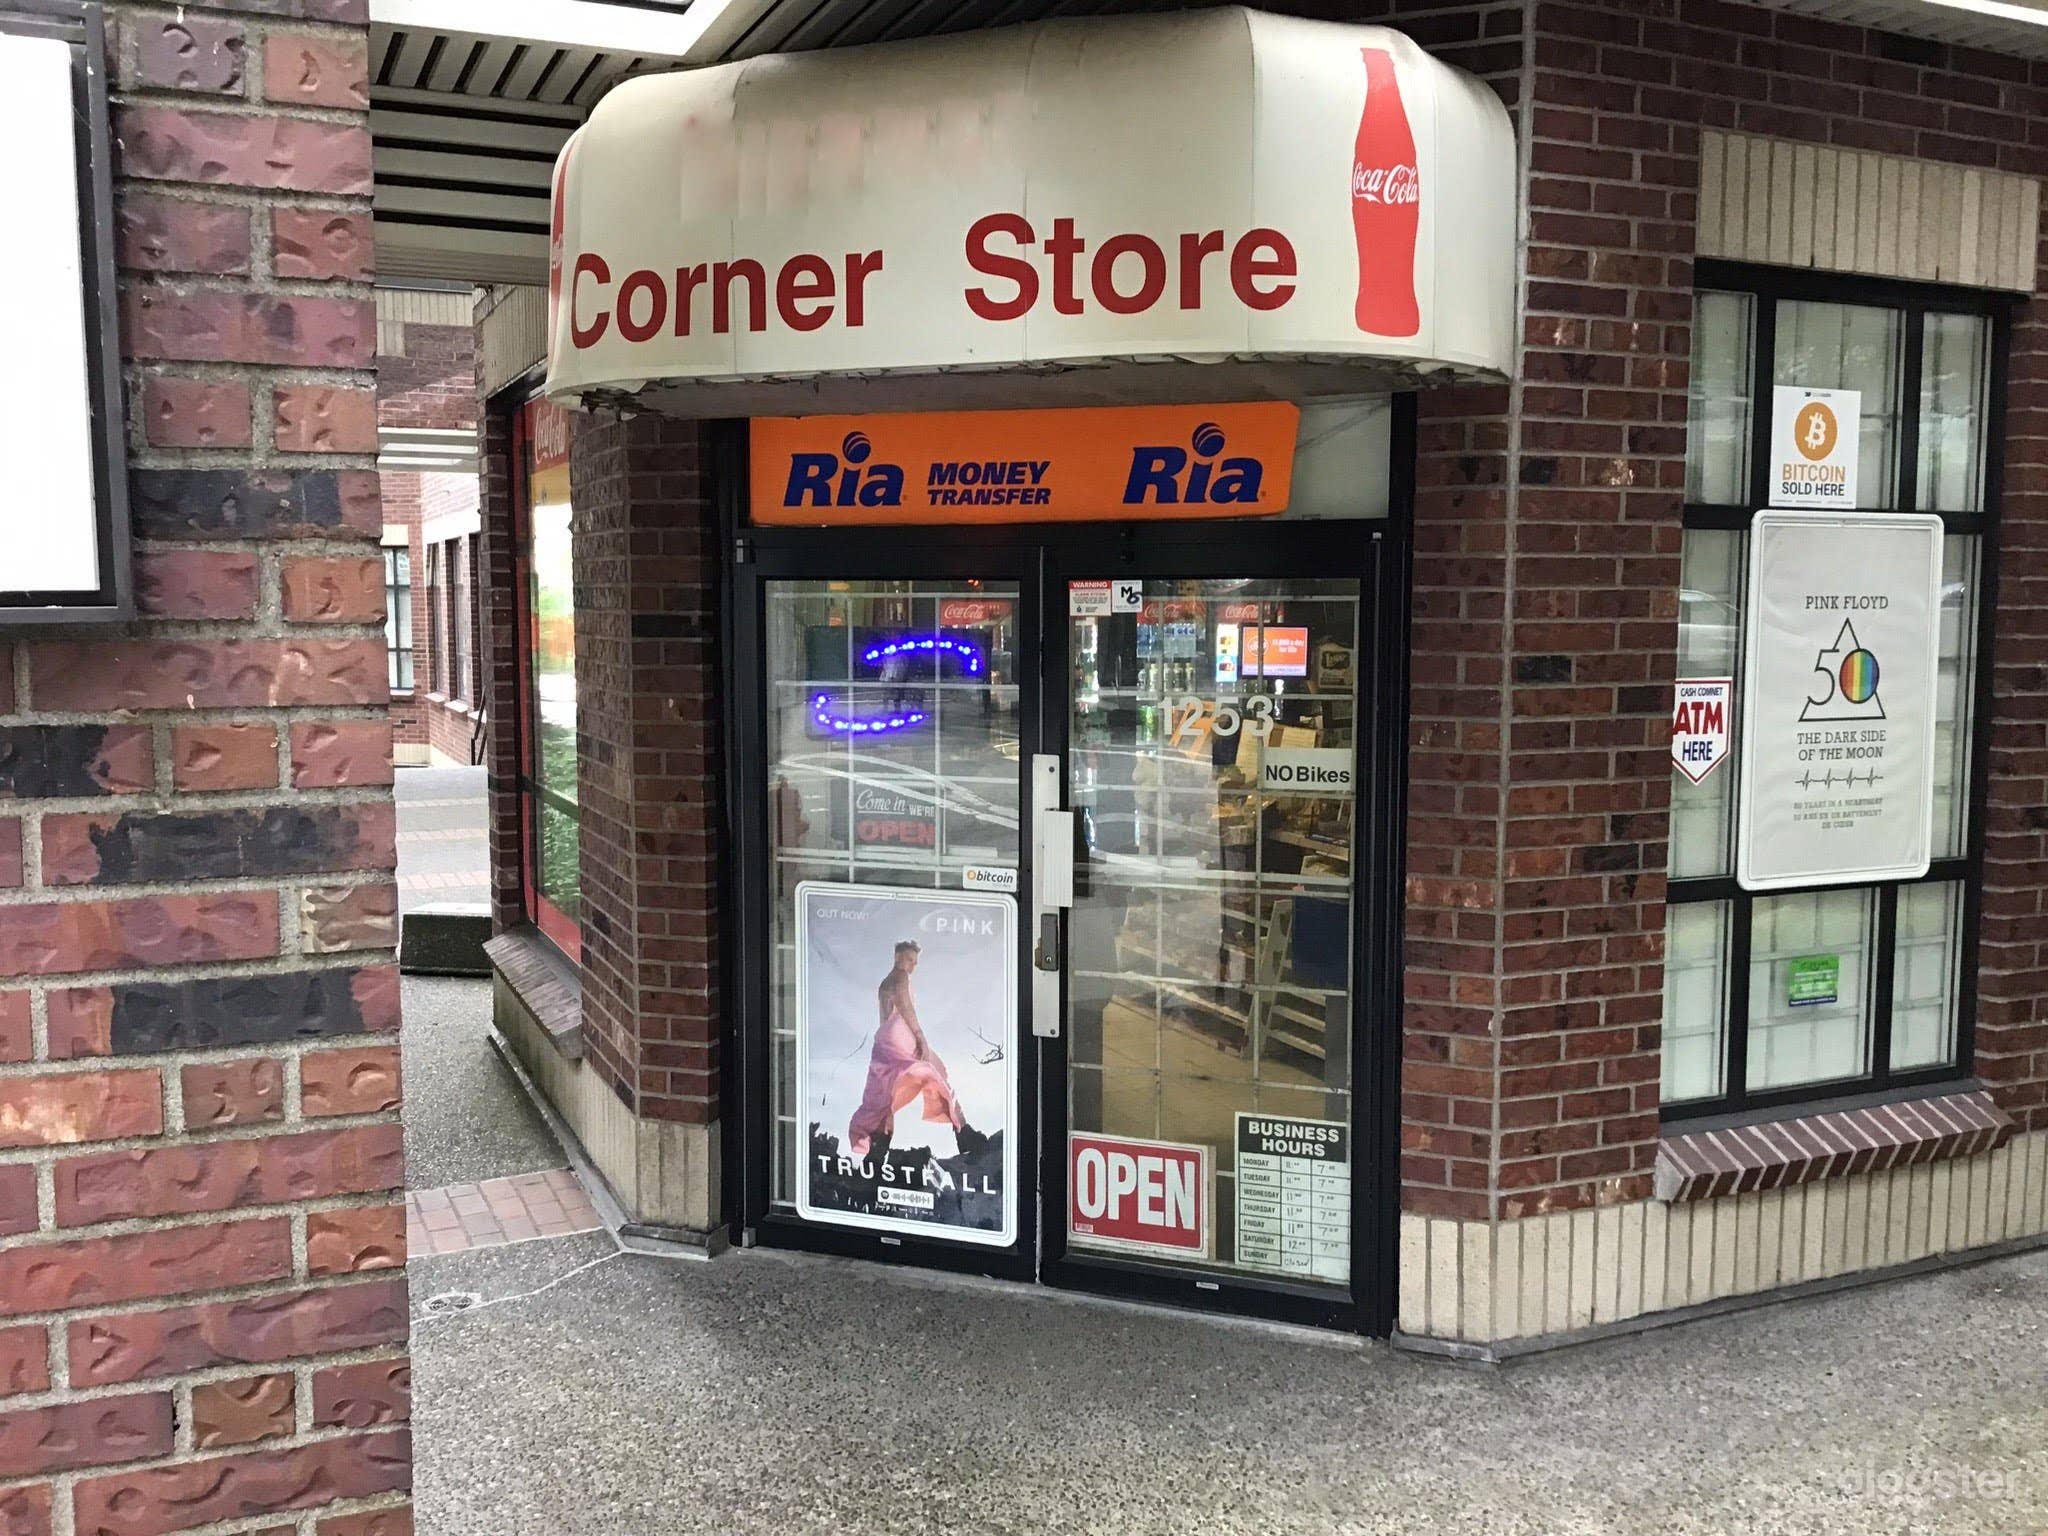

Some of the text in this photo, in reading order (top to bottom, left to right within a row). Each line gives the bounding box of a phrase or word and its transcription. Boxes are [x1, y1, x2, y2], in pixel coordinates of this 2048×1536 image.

[570, 249, 883, 349] Corner
[964, 212, 1298, 321] Store
[783, 422, 1264, 507] Ria MONEY Ria
[1782, 464, 1846, 482] BITCOIN
[927, 487, 1051, 506] TRANSFER
[1781, 482, 1845, 496] SOLD HERE
[1072, 580, 1108, 589] WARNING
[1805, 596, 1889, 610] PINK FLOYD
[1807, 648, 1880, 707] 50
[1680, 687, 1697, 697] CASH
[1159, 695, 1274, 737] 1253
[1673, 701, 1723, 735] ATM
[1797, 729, 1887, 745] THE DARK SIDE
[1682, 741, 1713, 761] HERE
[1798, 746, 1884, 761] OF THE MOON
[1266, 764, 1350, 783] NO Bikes
[856, 788, 936, 817] Come in WE'RE
[857, 819, 936, 846] OPEN
[976, 870, 1014, 883] bitcoin
[816, 908, 838, 919] OUT
[1248, 1120, 1340, 1143] BUSINESS
[1262, 1137, 1326, 1158] HOURS
[1243, 1157, 1269, 1167] MONDAY
[1243, 1172, 1271, 1182] TUESDAY
[1076, 1148, 1195, 1230] OPEN
[1243, 1188, 1279, 1199] WEDNESDAY
[1243, 1203, 1276, 1213] THURSDAY
[1243, 1219, 1266, 1228] FRIDAY
[1243, 1234, 1275, 1245] SATURDAY
[1243, 1250, 1269, 1260] SUNDAY
